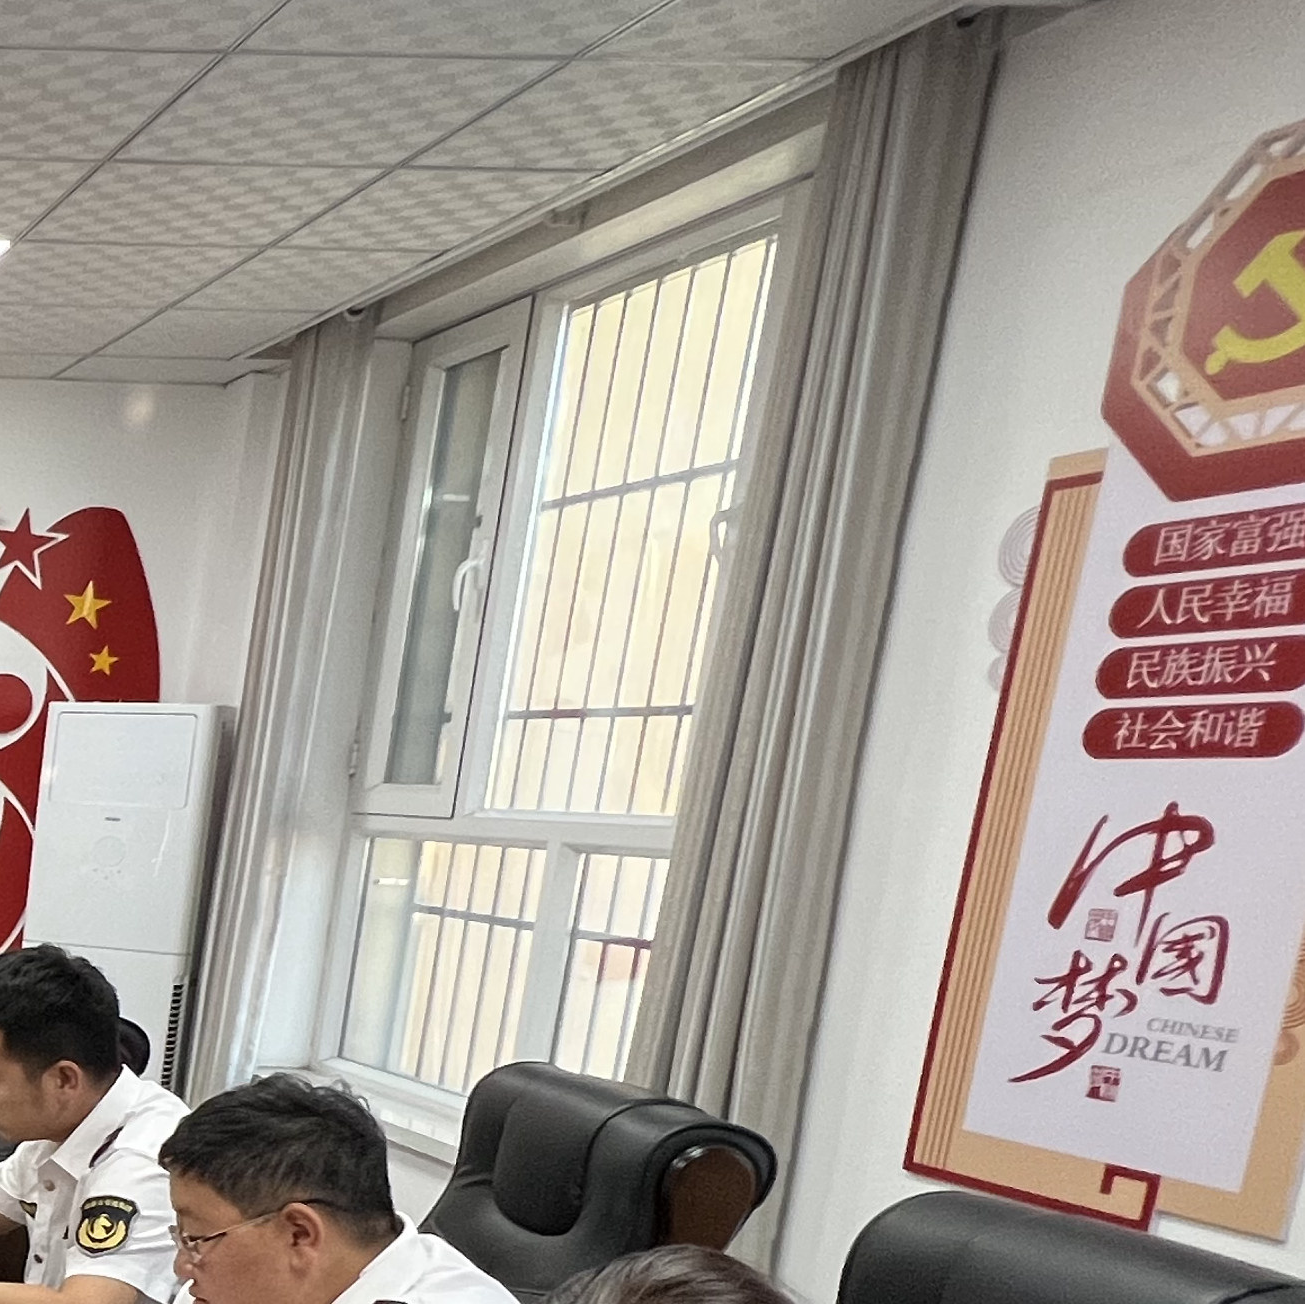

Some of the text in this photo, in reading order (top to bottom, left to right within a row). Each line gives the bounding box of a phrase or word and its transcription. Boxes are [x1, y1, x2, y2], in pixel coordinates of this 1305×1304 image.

[1154, 510, 1305, 567] 国家富强
[1137, 574, 1298, 629] 人民幸福
[1126, 643, 1279, 690] 民族振兴
[1113, 708, 1267, 750] 社会和谐
[1101, 1032, 1229, 1073] DREAM
[1146, 1017, 1242, 1044] CHINESE
